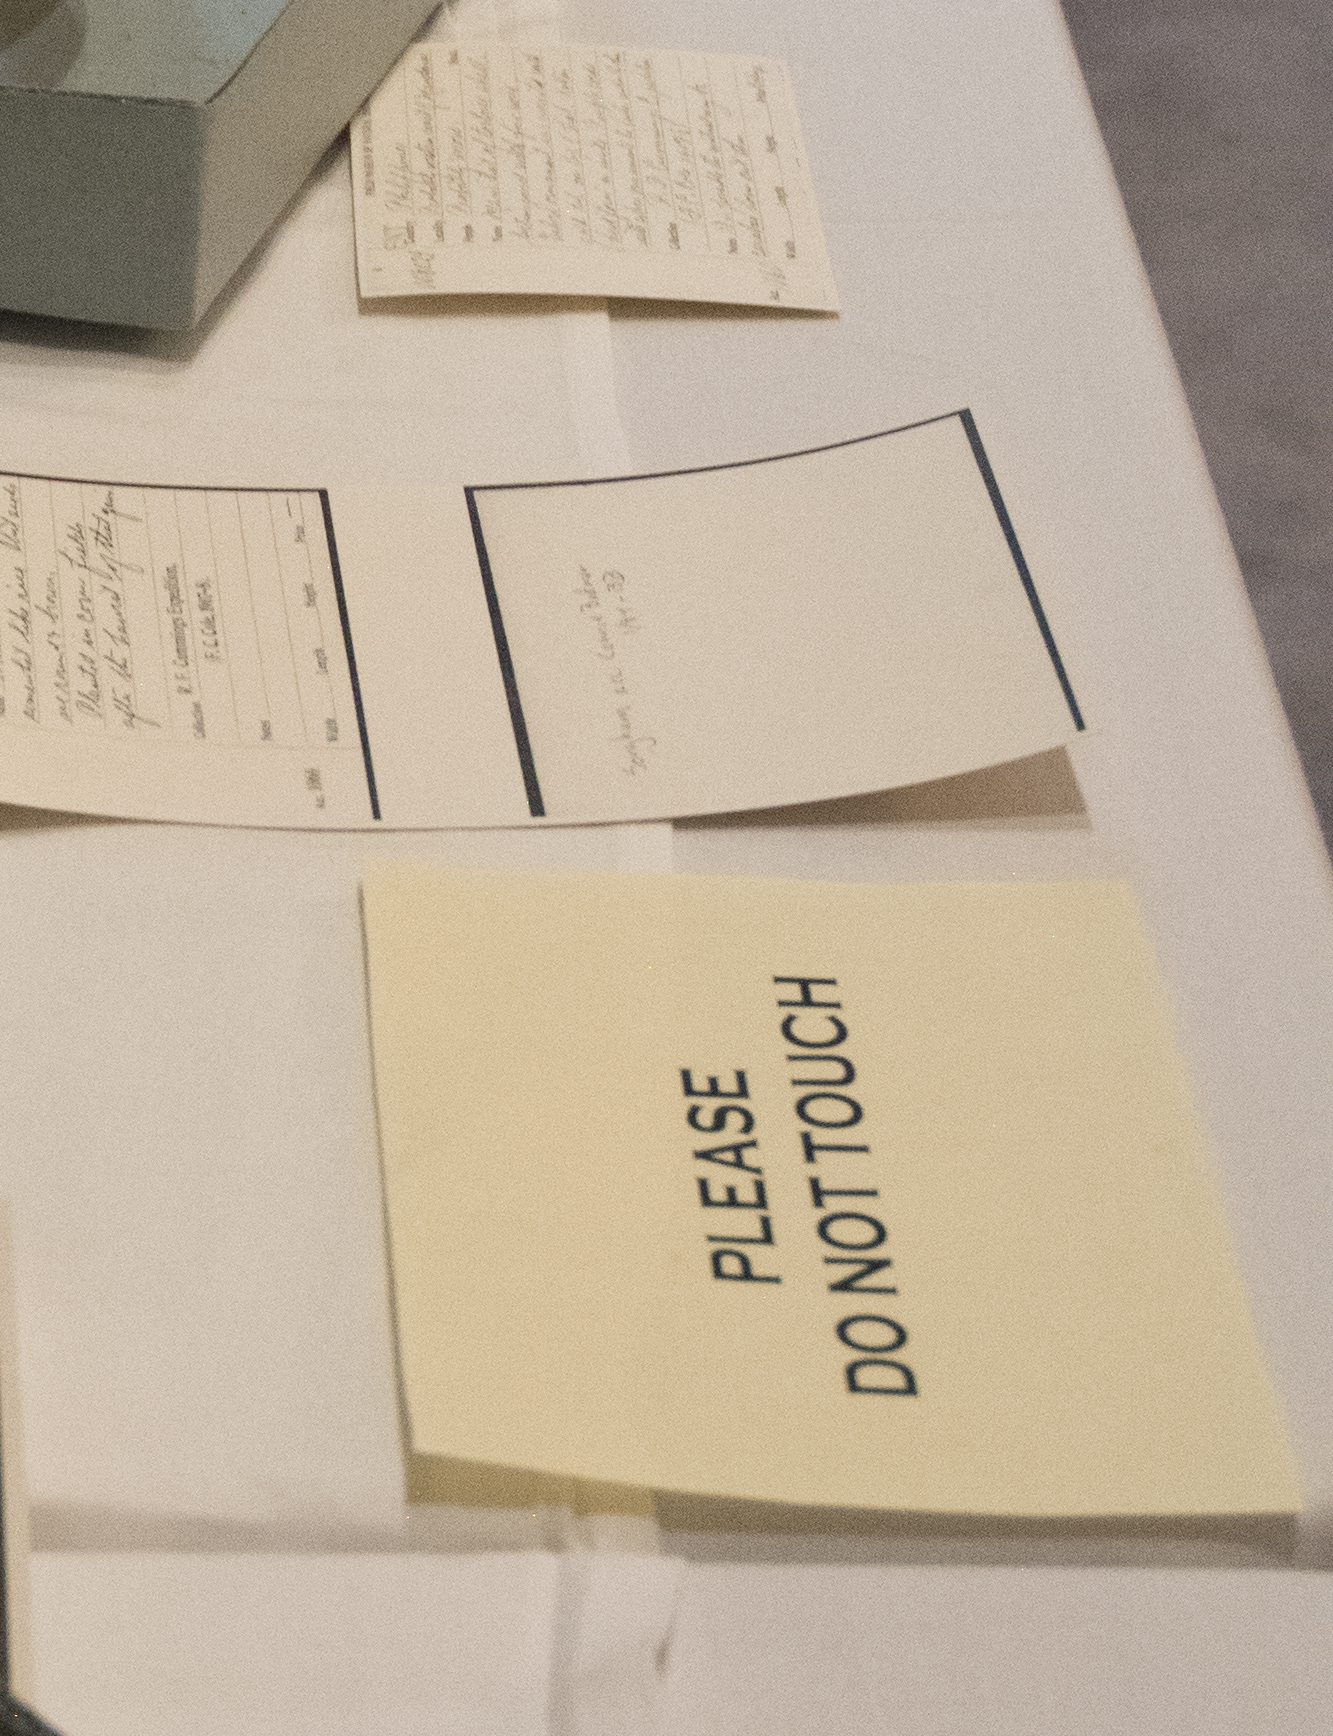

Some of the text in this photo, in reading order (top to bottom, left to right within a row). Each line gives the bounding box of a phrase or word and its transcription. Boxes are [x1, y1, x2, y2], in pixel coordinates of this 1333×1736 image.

[679, 1067, 782, 1285] PLEASE
[773, 975, 919, 1397] DO NOT TOUCH
